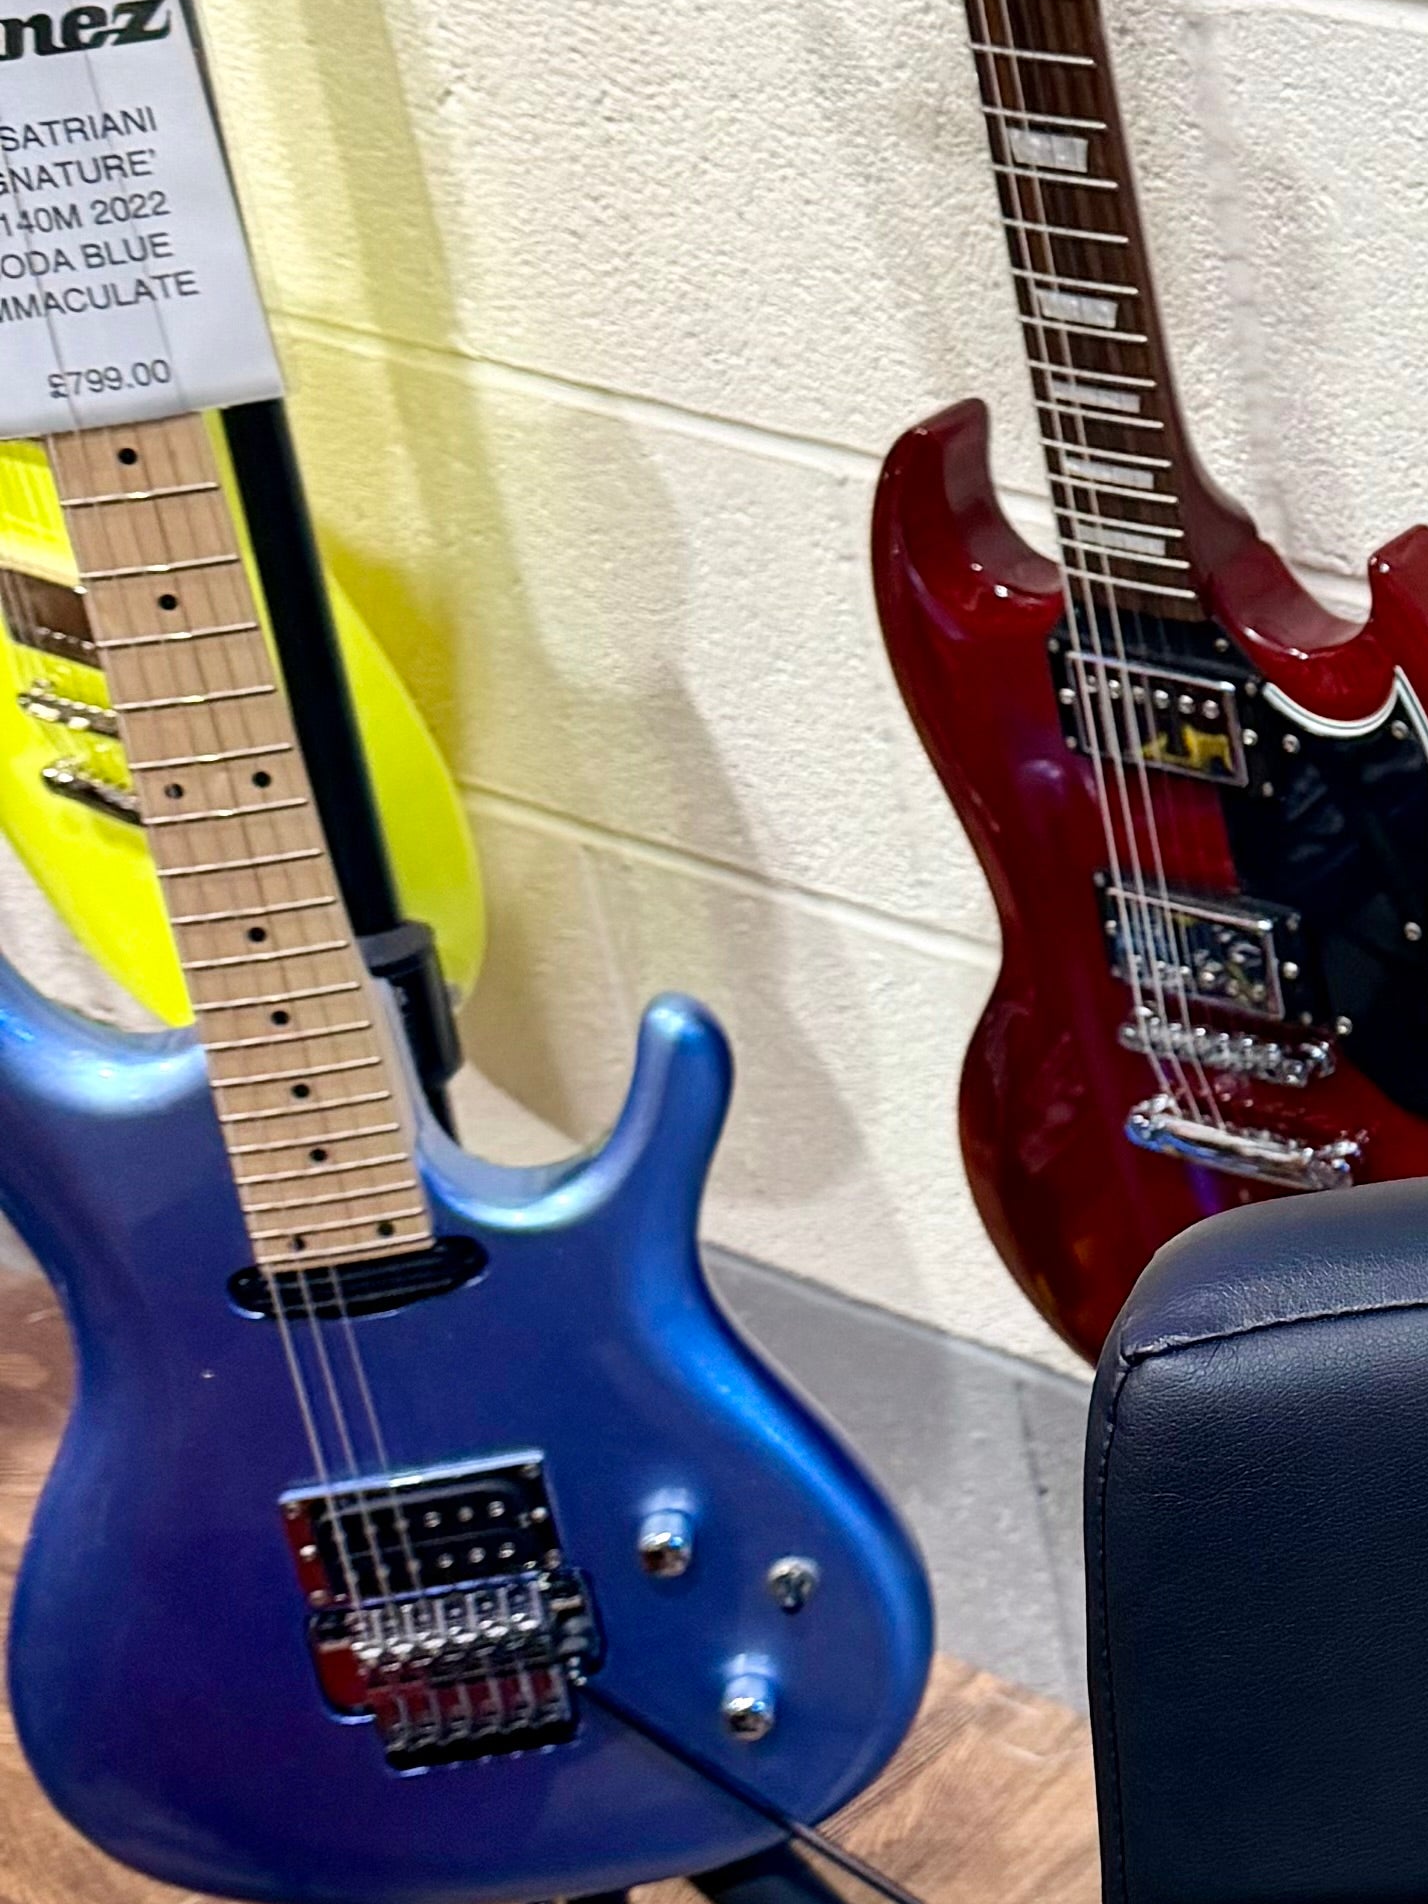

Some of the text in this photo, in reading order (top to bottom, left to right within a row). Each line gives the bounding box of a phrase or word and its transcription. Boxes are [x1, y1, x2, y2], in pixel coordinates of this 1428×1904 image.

[0, 106, 157, 152] SATRIANI
[90, 191, 171, 225] 2022
[0, 232, 174, 280] ODA BLUE
[48, 359, 172, 399] £799.00
